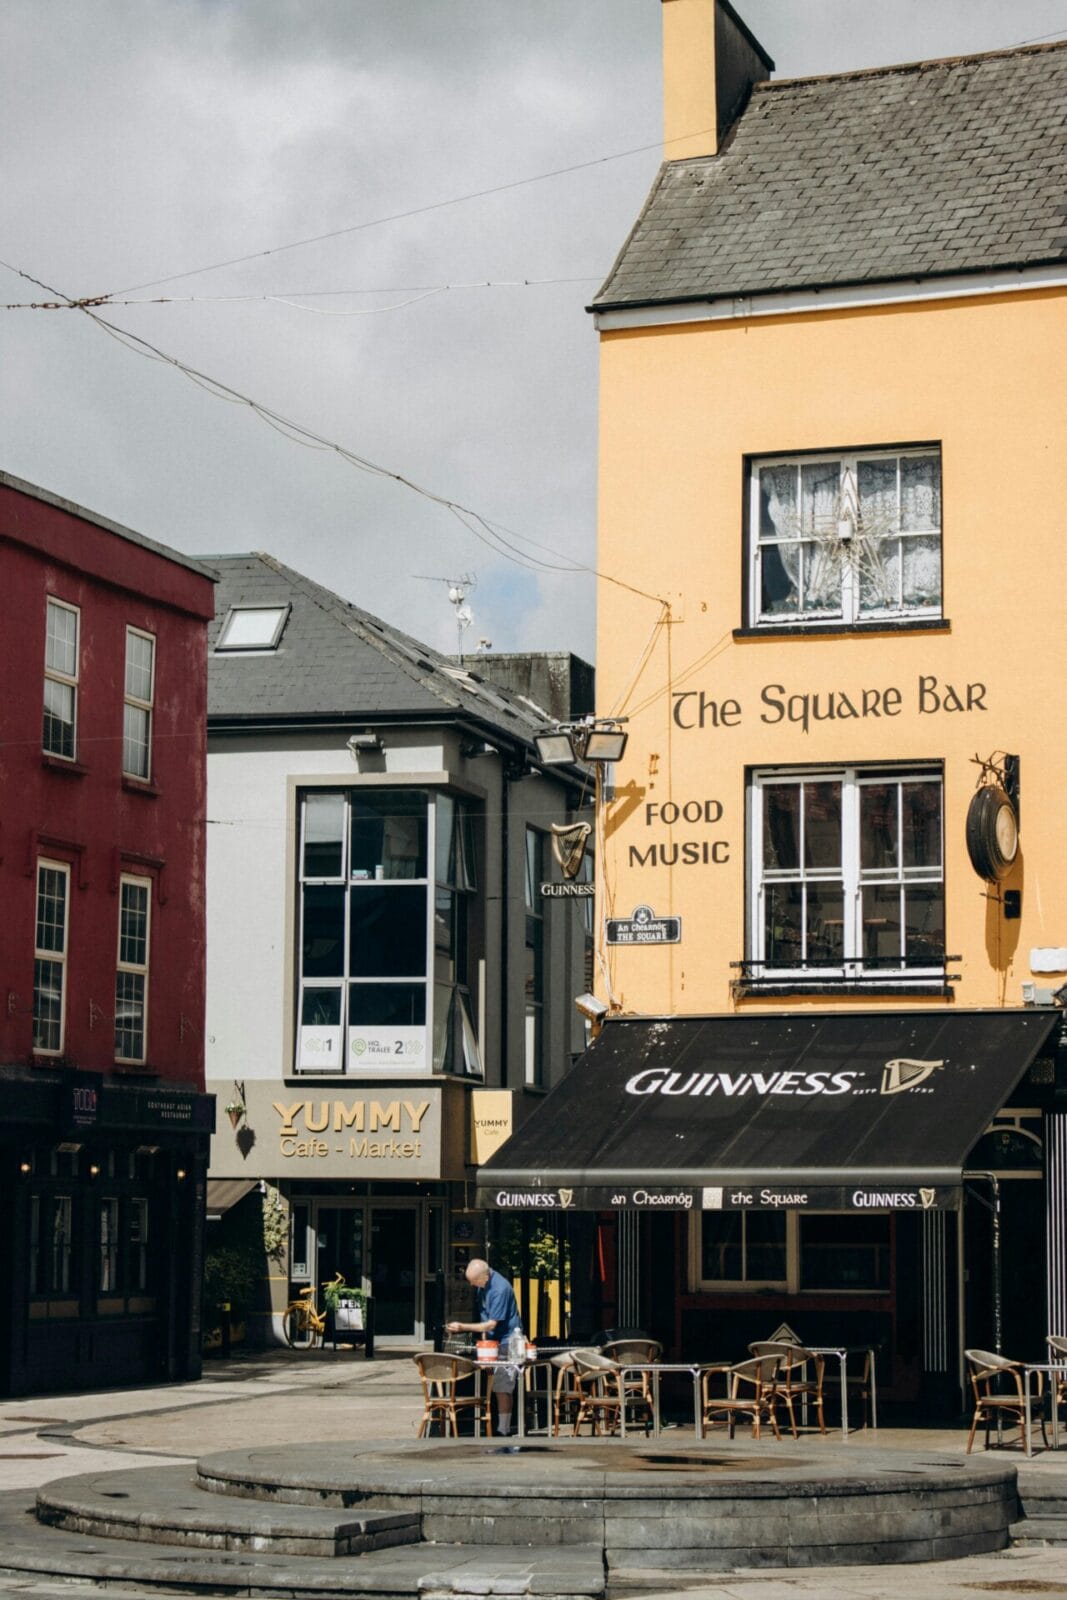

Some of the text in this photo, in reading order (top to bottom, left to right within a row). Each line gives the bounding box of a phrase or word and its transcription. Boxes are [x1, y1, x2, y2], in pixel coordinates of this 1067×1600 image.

[671, 690, 742, 729] The
[759, 684, 902, 735] Square
[645, 800, 723, 826] FOOD
[628, 841, 731, 867] MUSIC
[541, 884, 595, 896] GUINNESS
[617, 931, 667, 941] THE SQUARE
[325, 1038, 332, 1052] 1
[394, 1040, 404, 1054] 2
[625, 1068, 857, 1096] GUINNESS
[272, 1101, 431, 1136] YUMMY
[473, 1120, 508, 1128] YUMMY
[280, 1138, 329, 1158] Cafe
[350, 1138, 422, 1158] Market
[496, 1191, 557, 1207] GUINNESS
[611, 1194, 626, 1205] an
[731, 1189, 808, 1208] the Square
[852, 1190, 917, 1207] GUINNESS
